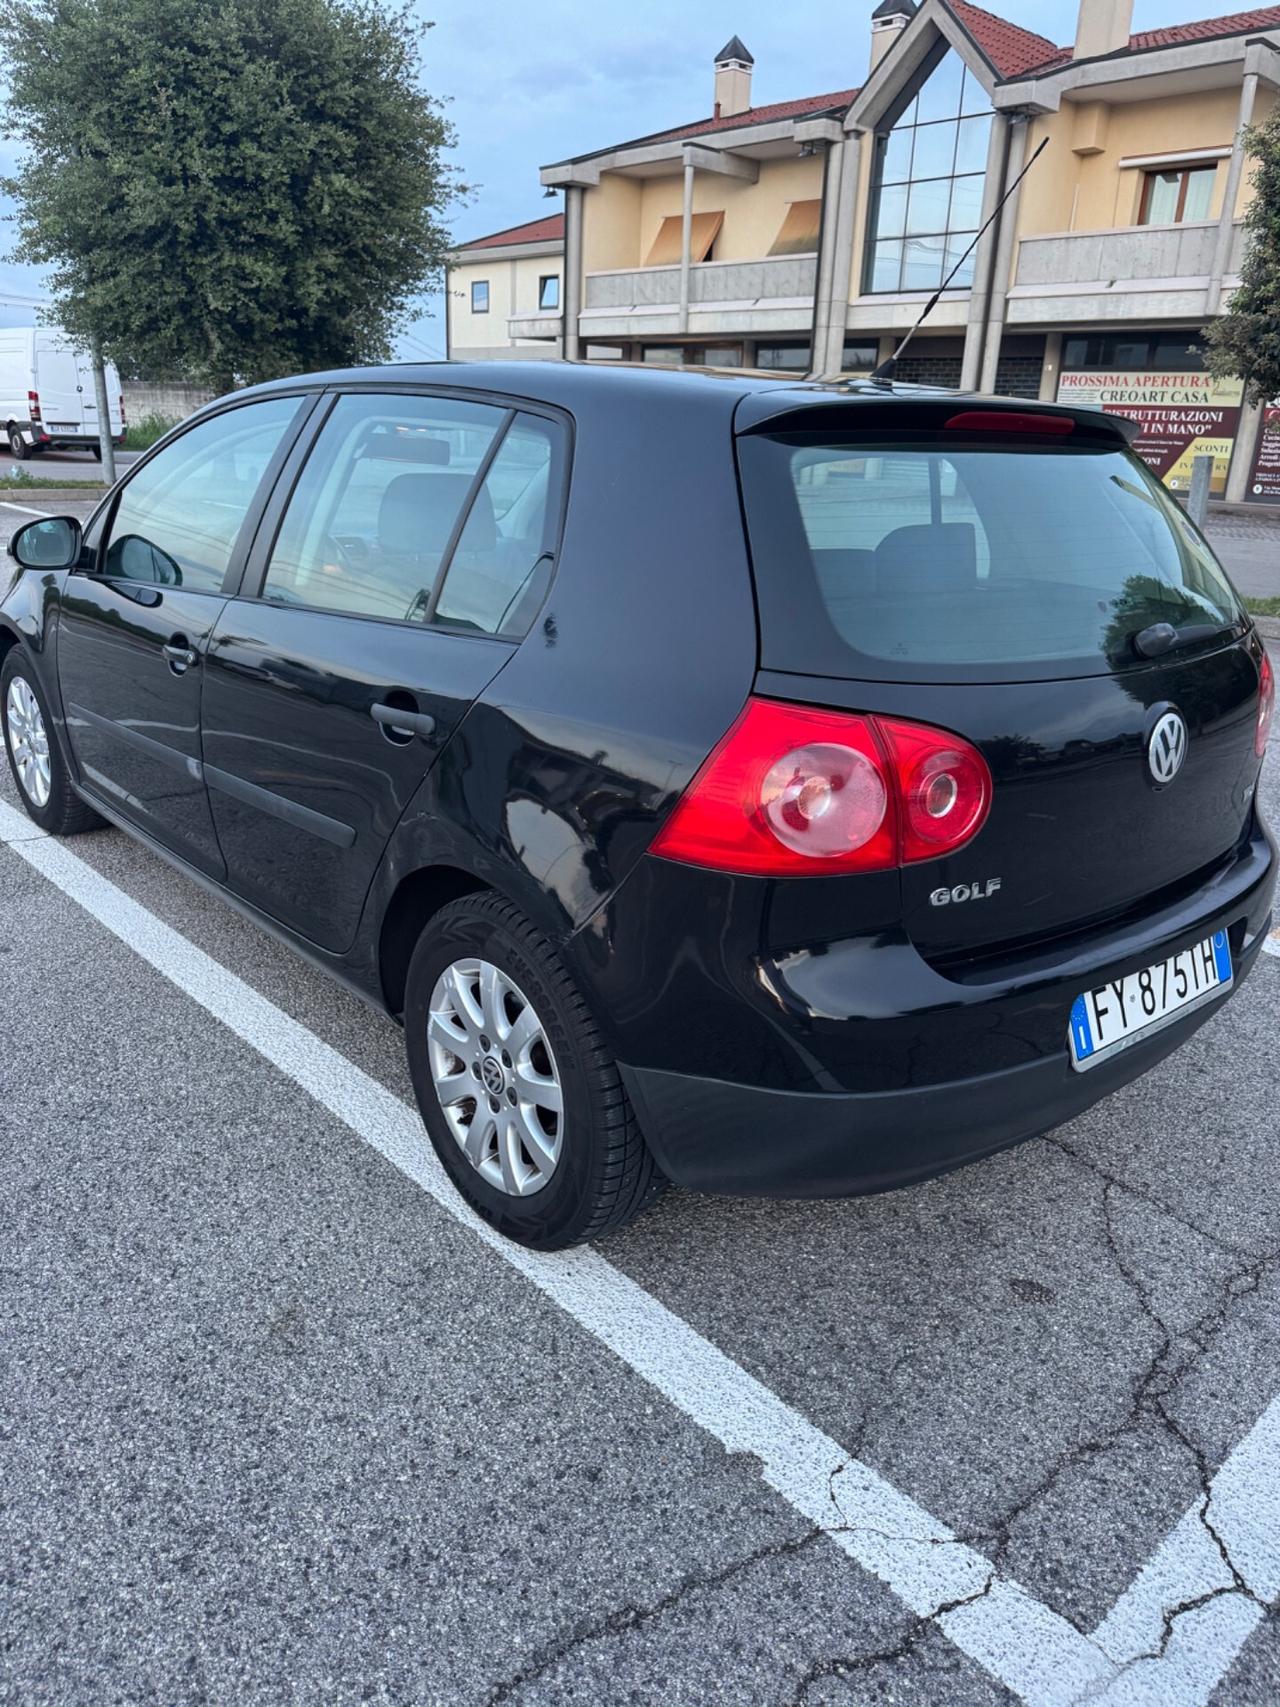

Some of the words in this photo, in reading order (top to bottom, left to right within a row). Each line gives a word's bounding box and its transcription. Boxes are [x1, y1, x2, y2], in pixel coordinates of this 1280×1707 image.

[1061, 375, 1129, 387] PROSSIMA
[1133, 375, 1211, 388] APERTURA
[1100, 390, 1167, 403] CREOART
[1170, 391, 1209, 403] CASA
[1150, 423, 1163, 433] IN
[1193, 444, 1228, 453] SCONTI
[930, 878, 1002, 906] GOLF
[1091, 978, 1128, 1041] FY
[1138, 938, 1217, 1016] 875TH
